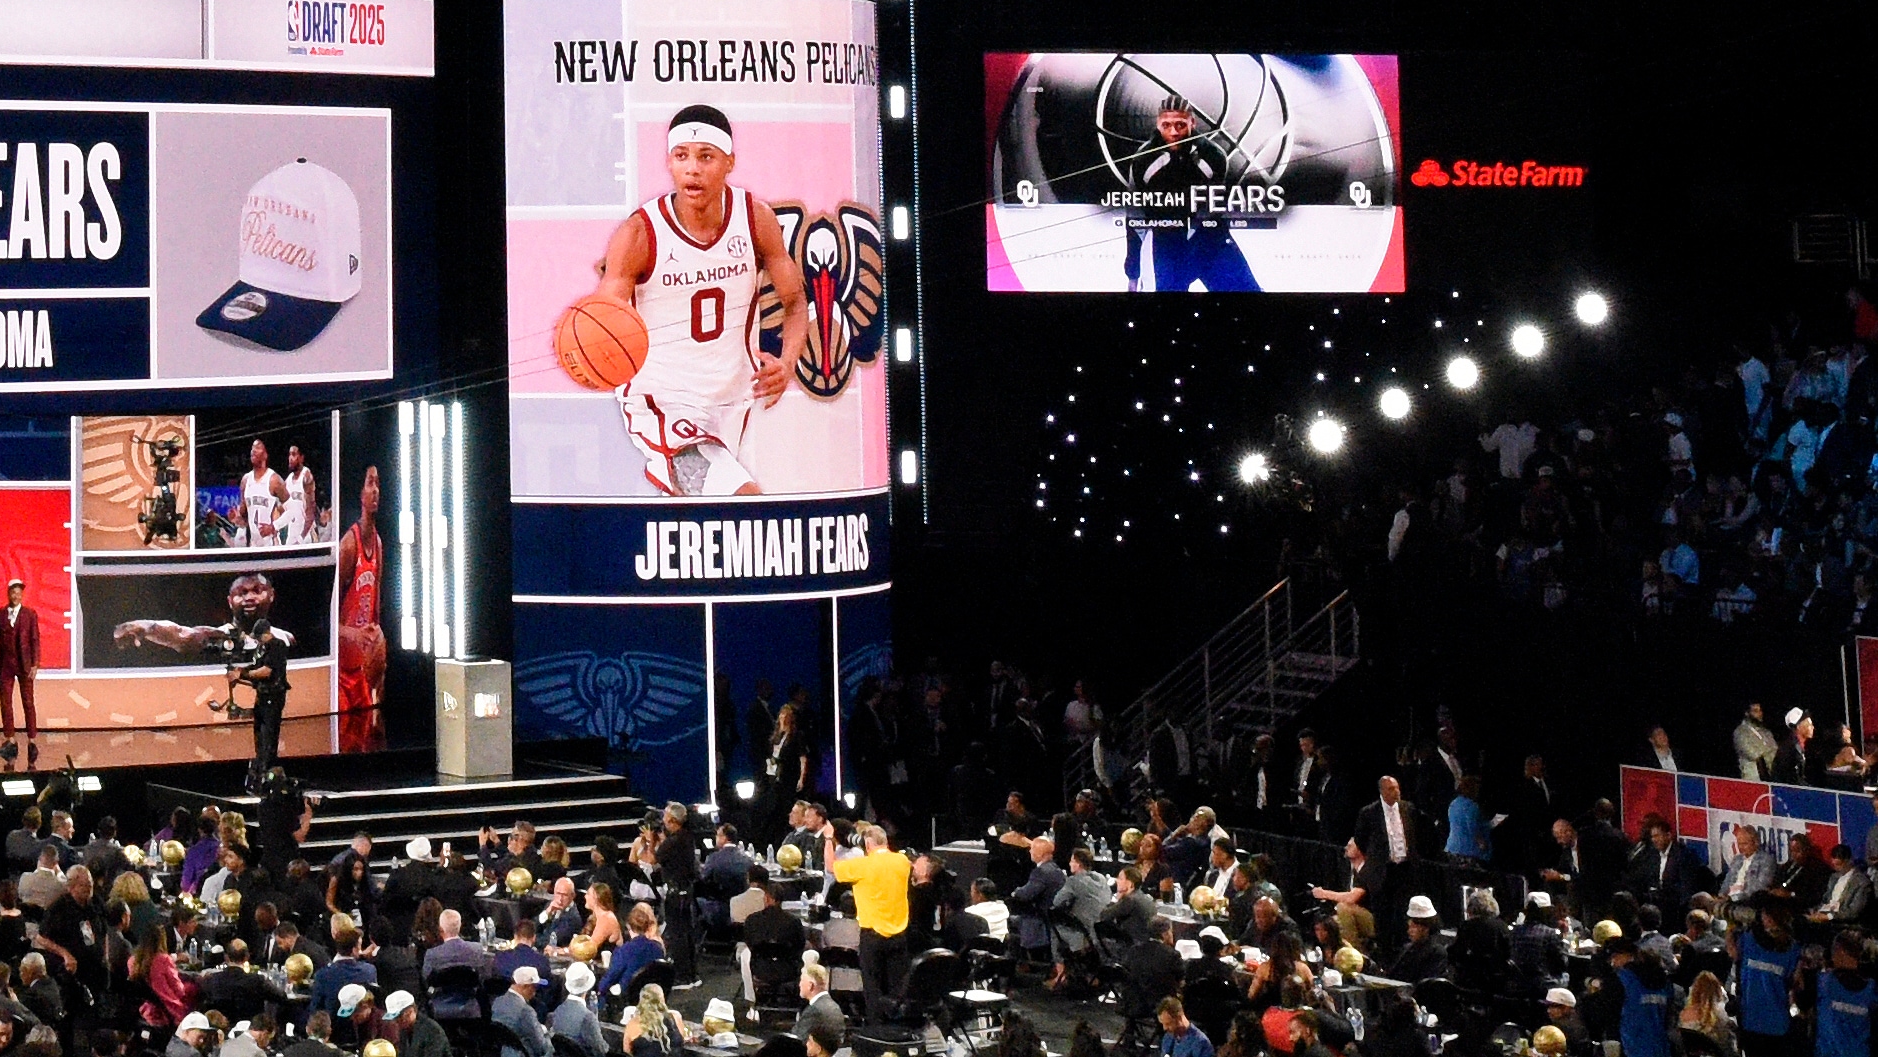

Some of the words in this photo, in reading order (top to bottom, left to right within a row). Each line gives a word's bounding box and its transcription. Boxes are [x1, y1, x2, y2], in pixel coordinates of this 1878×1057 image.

[302, 1, 346, 43] DRAFT
[349, 3, 385, 45] 2025
[553, 40, 638, 83] NEW
[653, 39, 796, 82] ORLEANS
[1100, 191, 1185, 207] JEREMIAH
[1190, 185, 1285, 213] FEARS
[241, 210, 319, 272] Pelicans
[662, 262, 748, 287] OKLAHOMA
[690, 287, 725, 343] 0
[635, 518, 803, 580] JEREMIAH
[809, 513, 869, 574] FEARS
